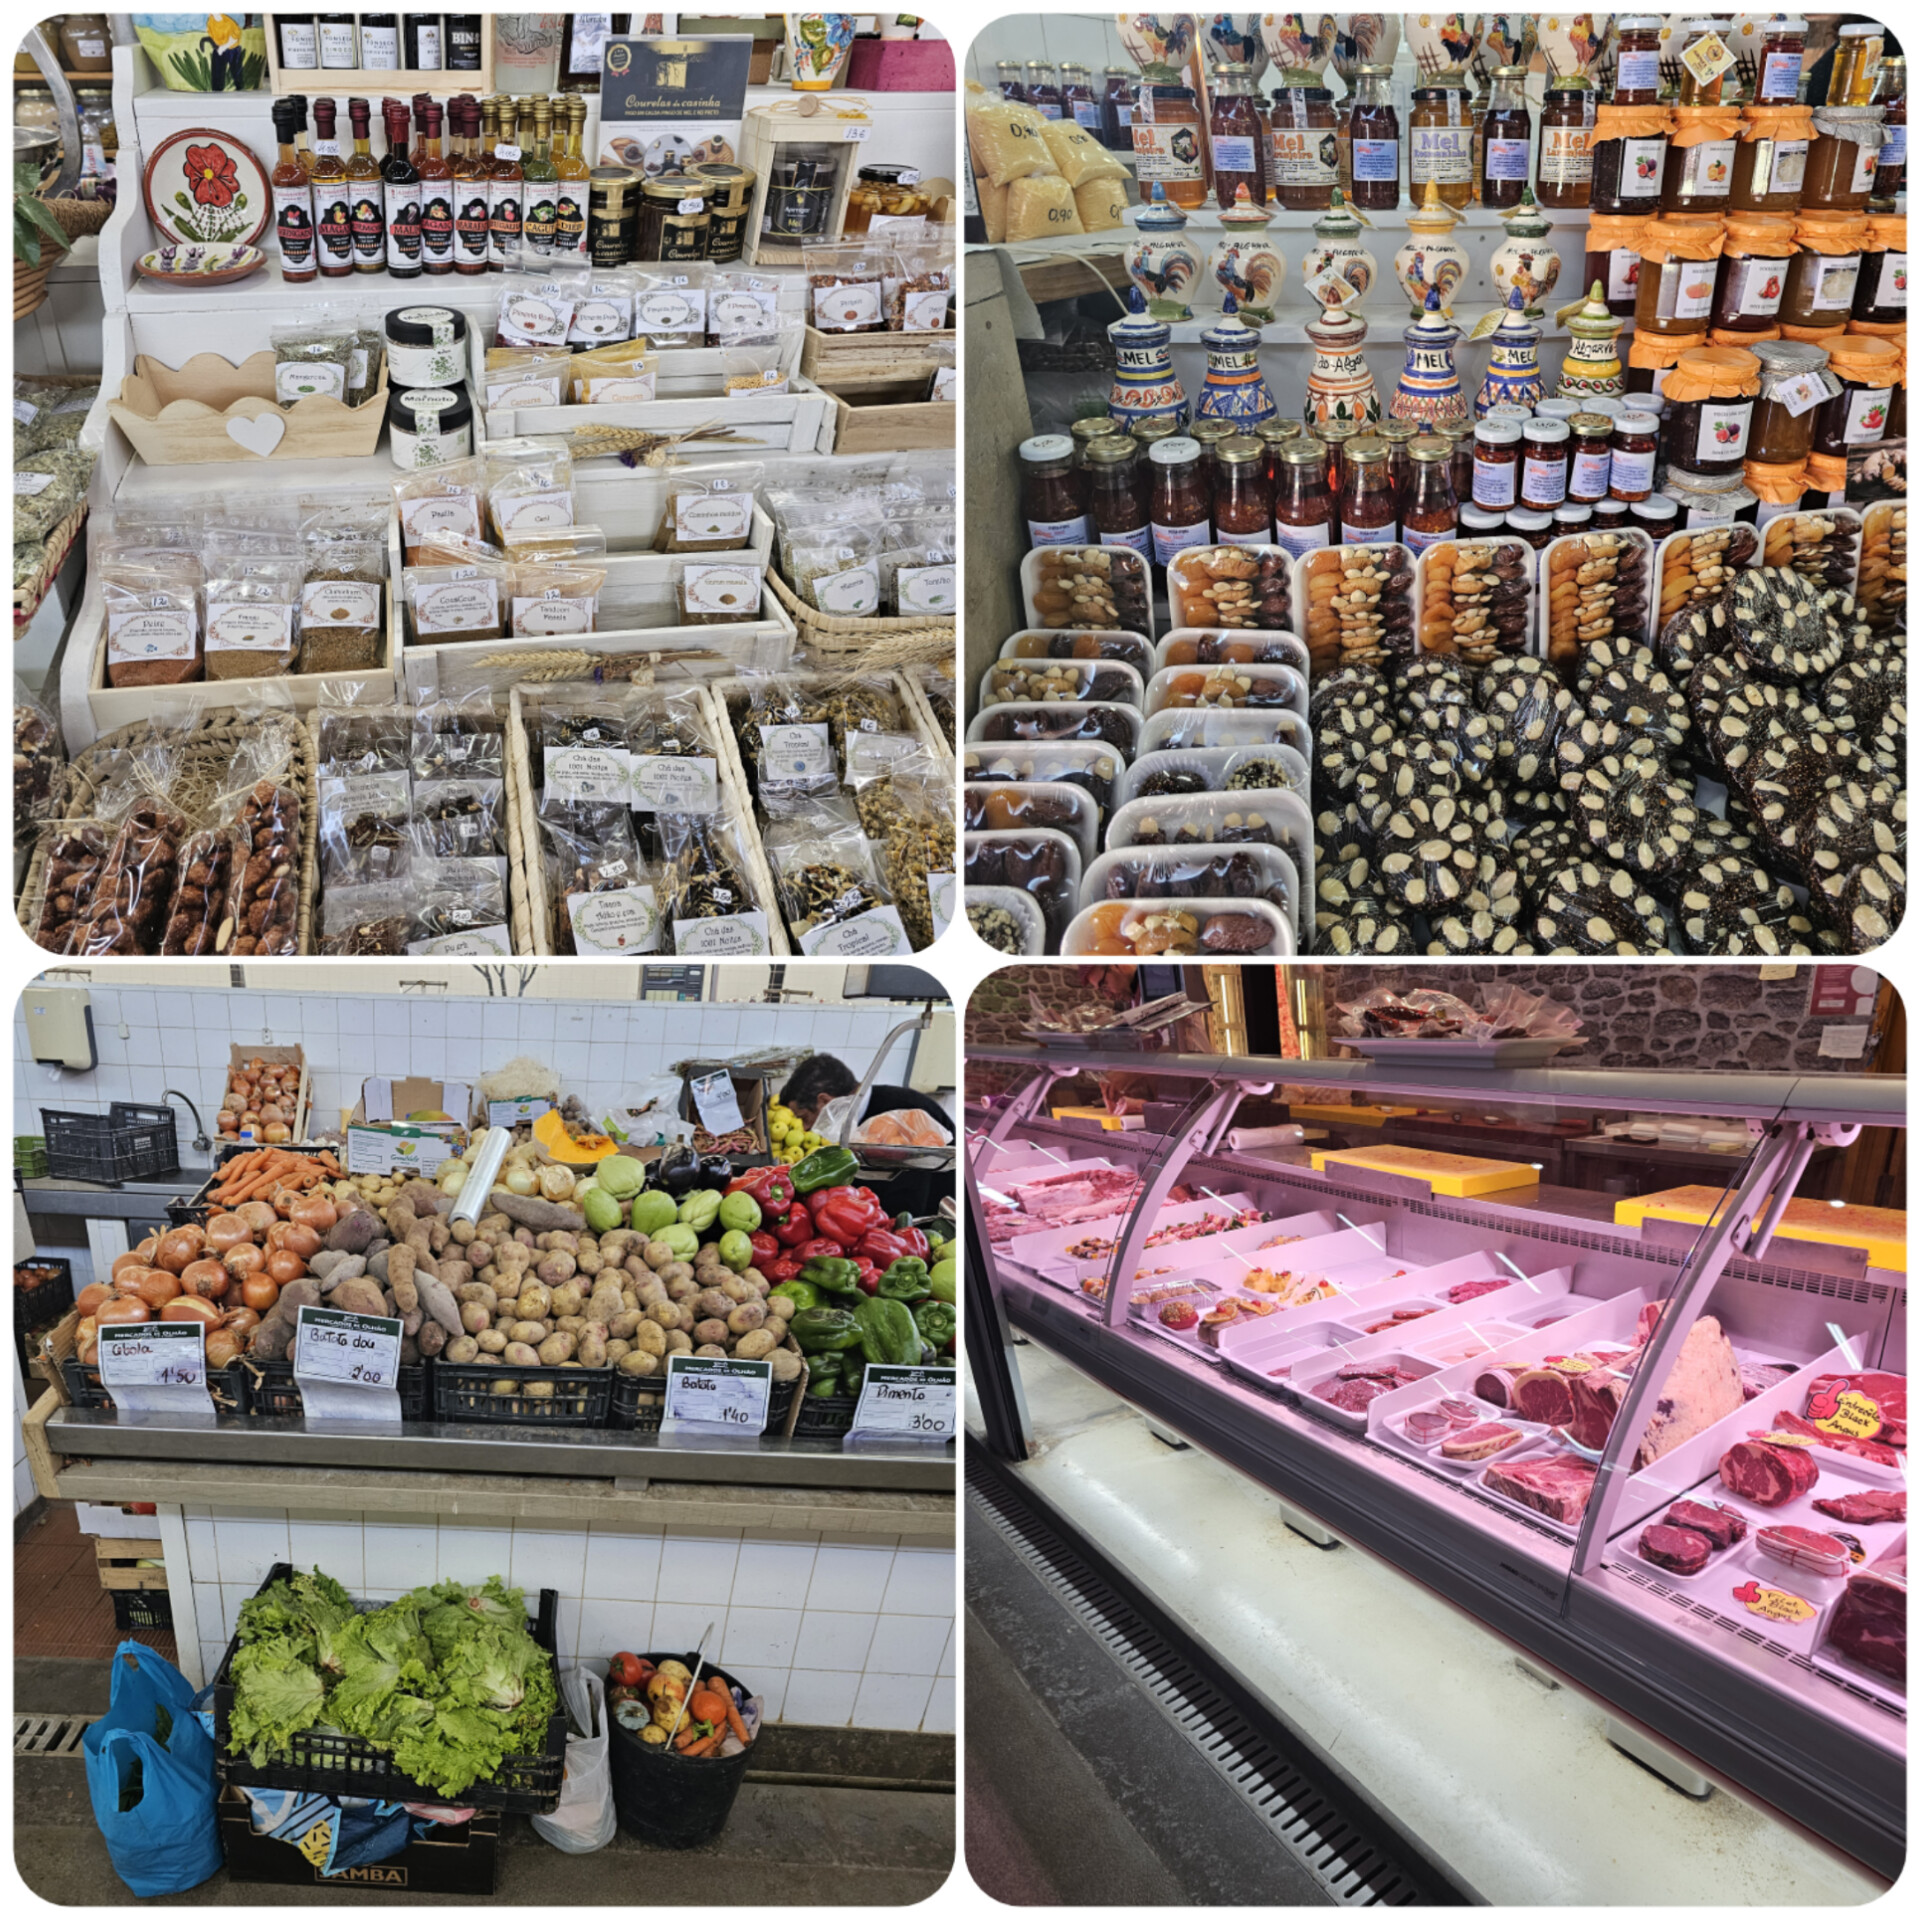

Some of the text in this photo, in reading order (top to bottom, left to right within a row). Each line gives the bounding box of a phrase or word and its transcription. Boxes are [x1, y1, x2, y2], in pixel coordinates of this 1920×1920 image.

[625, 94, 672, 108] Courelas
[681, 94, 721, 108] casinha
[1133, 128, 1156, 145] el
[1421, 133, 1460, 150] Mel
[1553, 132, 1590, 149] Mel
[1048, 208, 1073, 222] 0,90
[1122, 352, 1154, 366] MEL
[1214, 356, 1243, 368] MEL
[1416, 352, 1445, 369] MEL
[1508, 348, 1533, 364] MEL
[314, 1316, 350, 1327] MERCADOS
[114, 1332, 151, 1340] MERCADOS
[162, 1329, 188, 1337] OLHÃO
[685, 1365, 723, 1374] MERCADOS
[732, 1367, 757, 1376] OLHÃO
[1840, 1408, 1870, 1428] Black
[1827, 1420, 1860, 1438] Angus
[329, 1868, 402, 1883] AMBA
